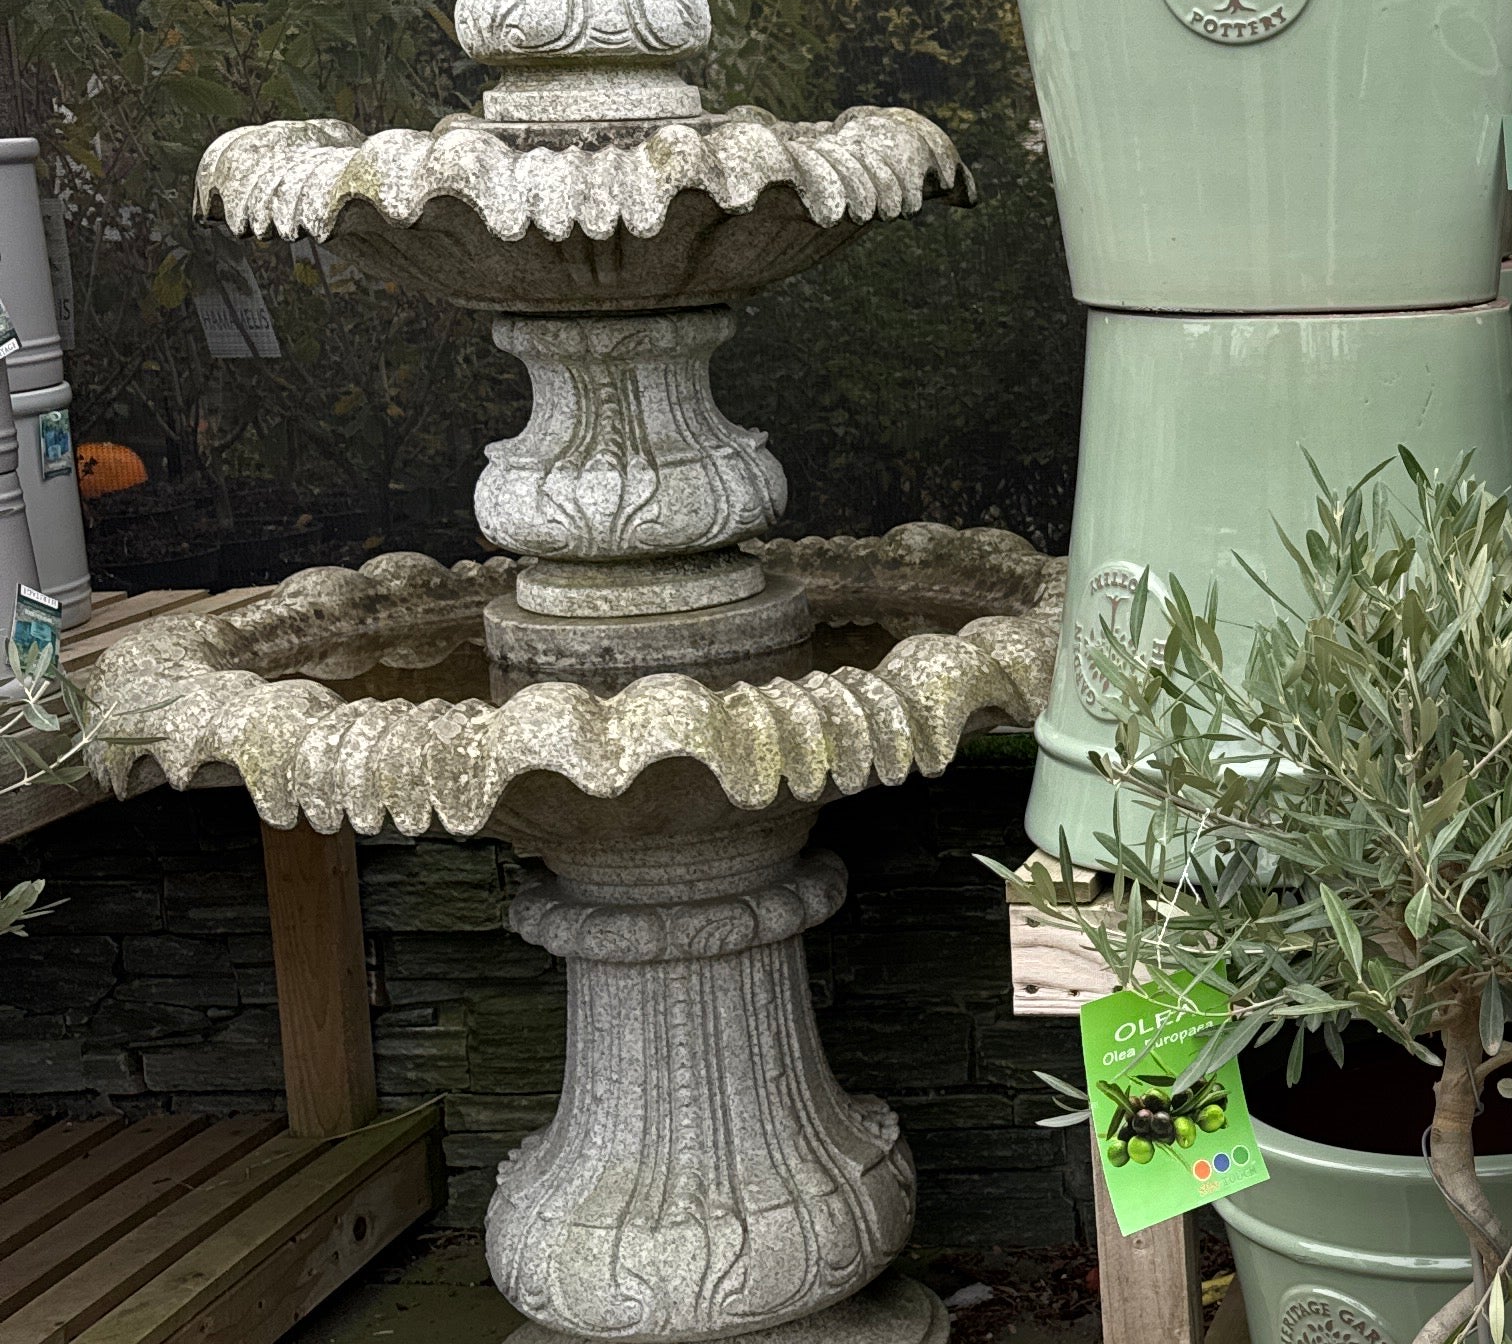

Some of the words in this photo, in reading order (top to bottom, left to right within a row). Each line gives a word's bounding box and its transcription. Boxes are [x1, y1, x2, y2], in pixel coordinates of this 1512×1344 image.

[1190, 6, 1287, 38] POTTERY
[1090, 571, 1139, 596] OTTERY
[1102, 1047, 1136, 1066] Olea
